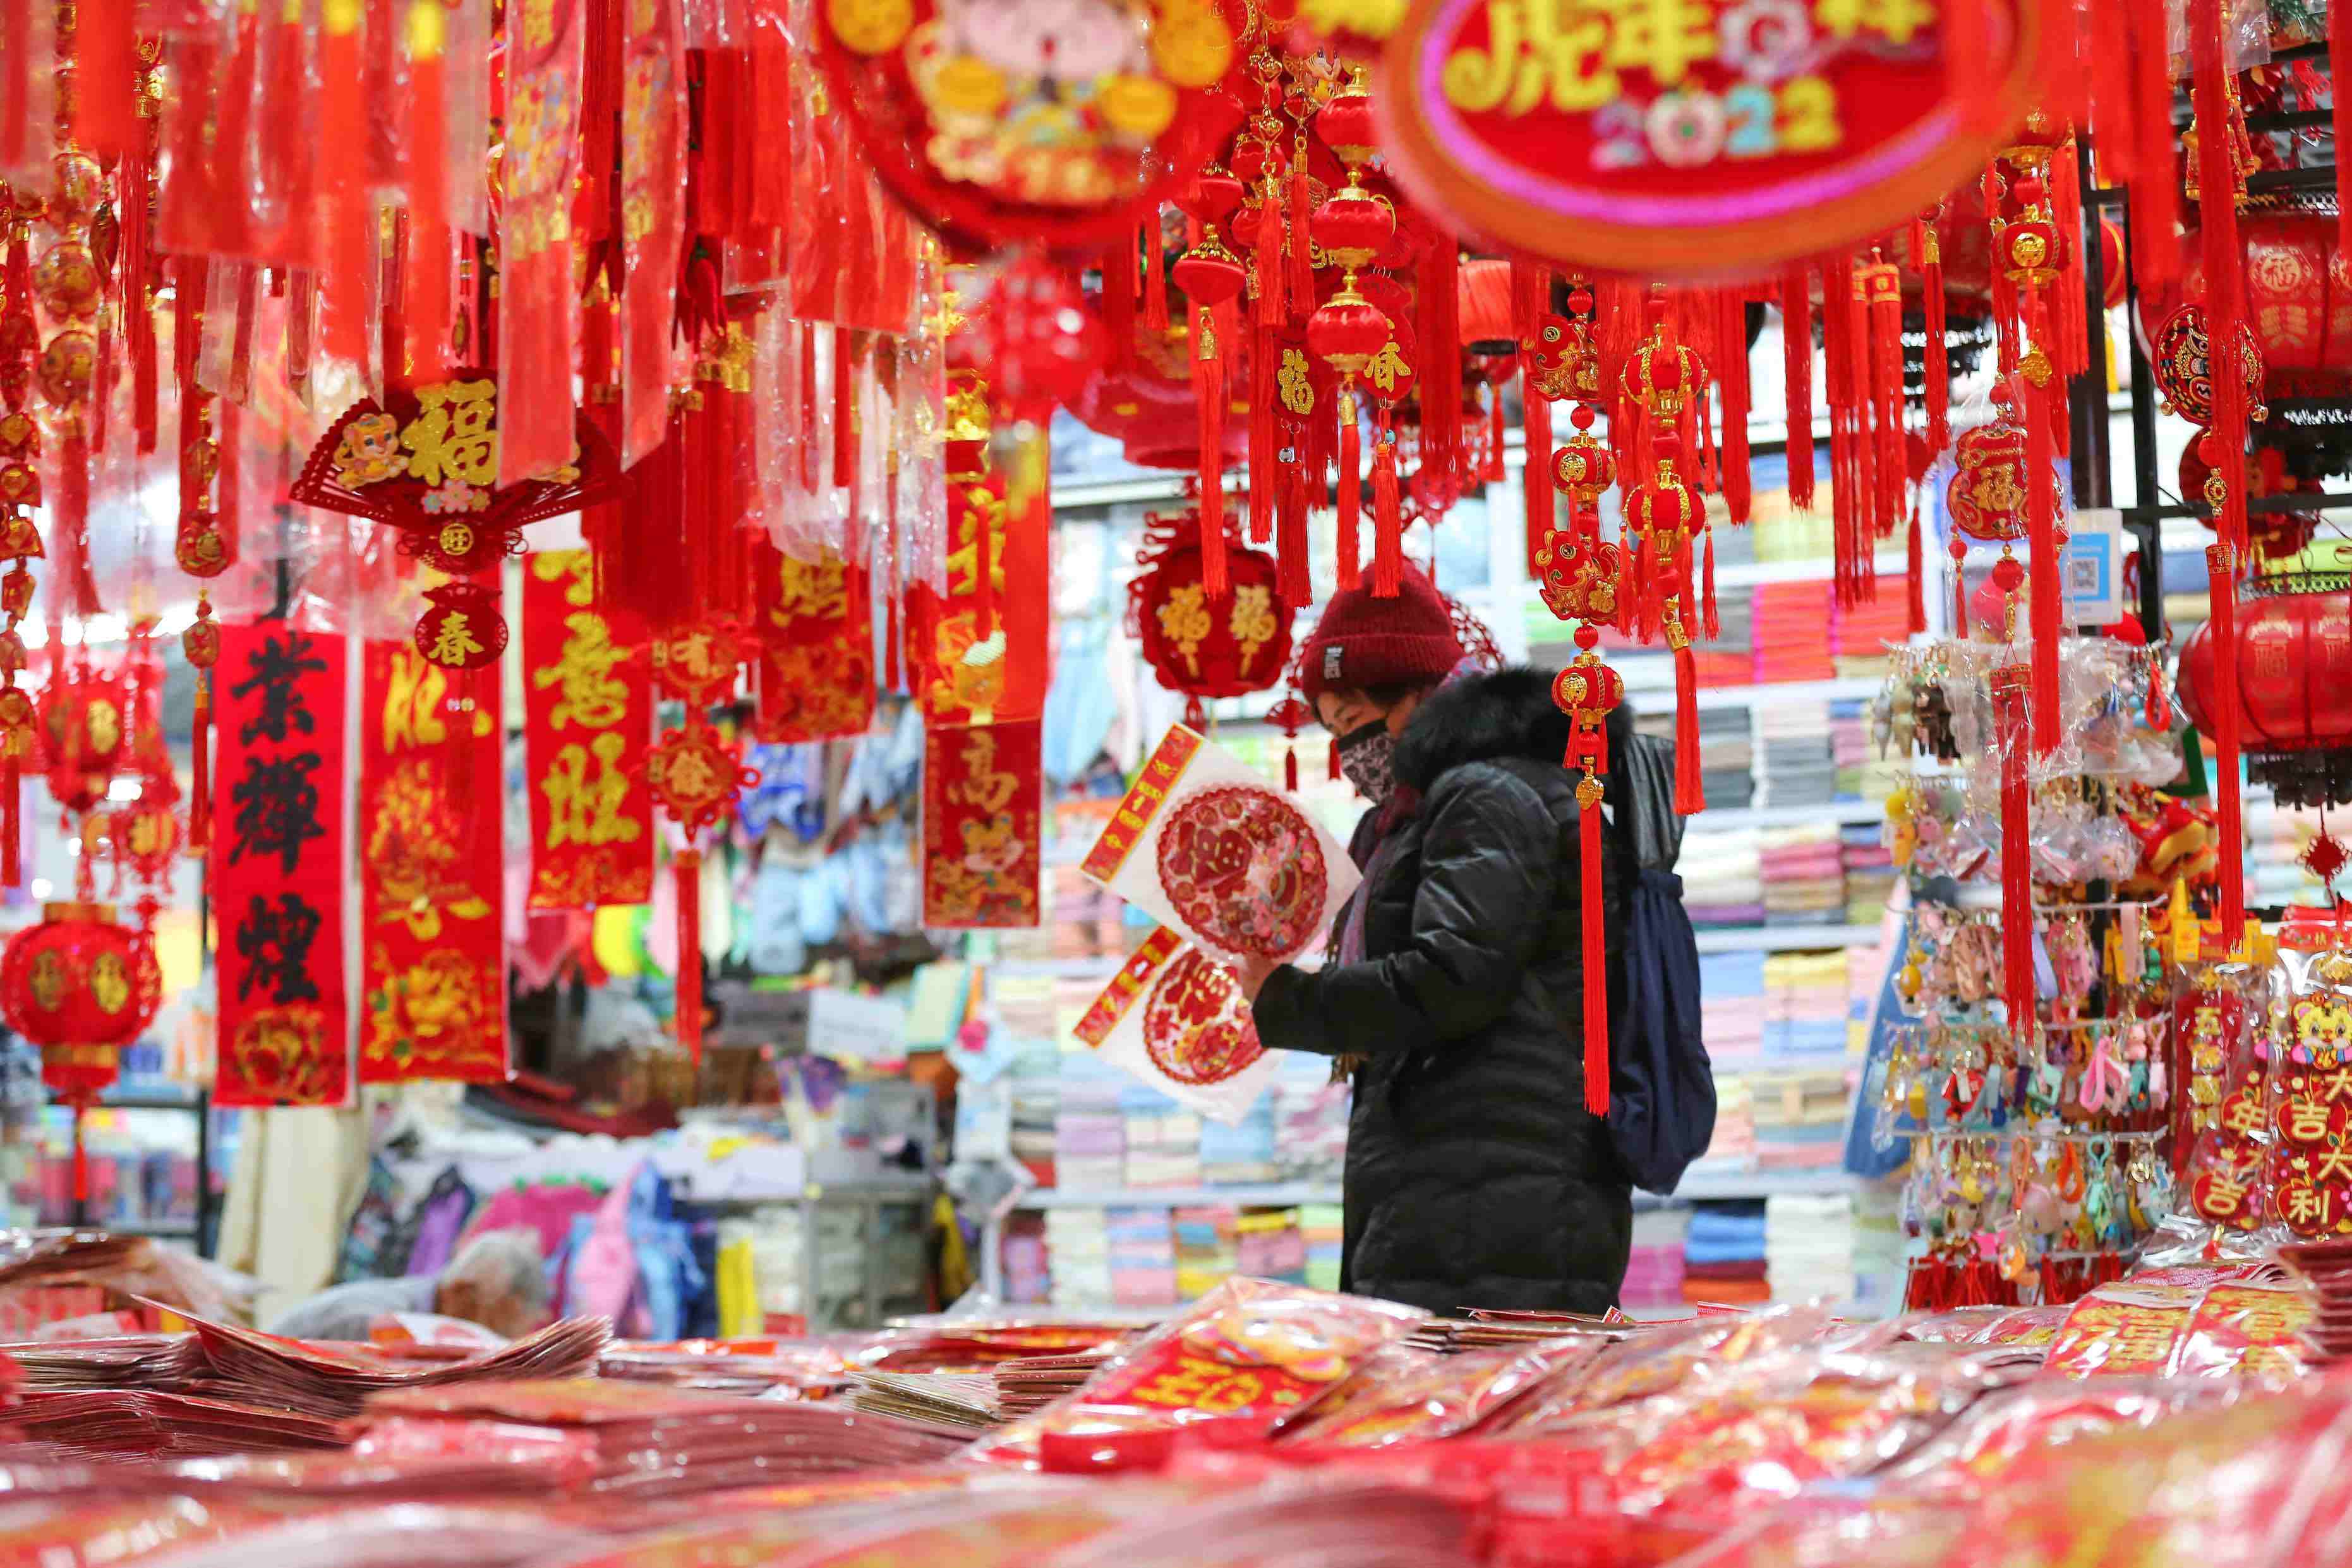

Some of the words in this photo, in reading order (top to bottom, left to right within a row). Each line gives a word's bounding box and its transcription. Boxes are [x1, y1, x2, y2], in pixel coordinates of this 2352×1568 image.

[1589, 75, 1841, 169] 2022
[1277, 348, 1315, 415] 福
[401, 379, 497, 486] 福
[428, 610, 484, 666] 春
[230, 505, 327, 1006] 業輝煌
